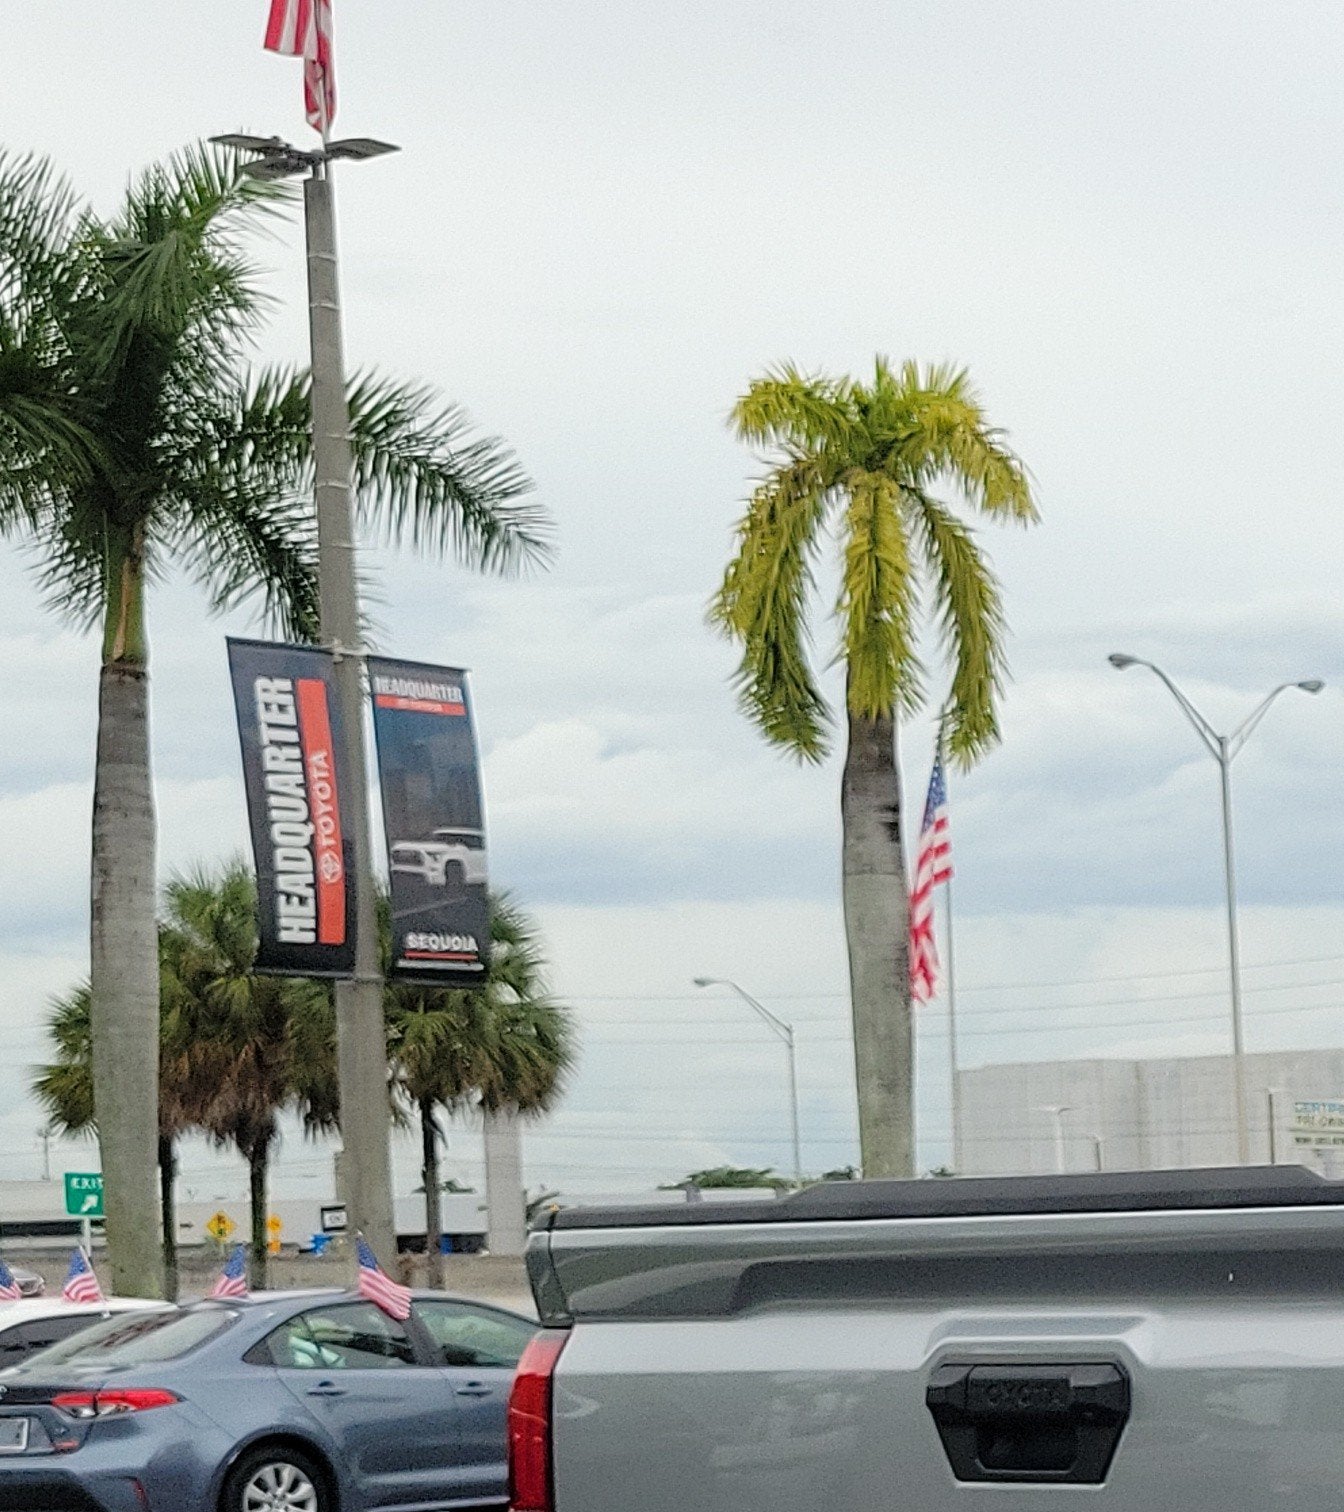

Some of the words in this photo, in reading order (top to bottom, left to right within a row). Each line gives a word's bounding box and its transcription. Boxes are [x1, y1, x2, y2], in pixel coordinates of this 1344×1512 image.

[255, 677, 316, 942] HEADQUARTER
[310, 751, 337, 845] TOYOTA
[406, 932, 478, 952] SEQUOIA
